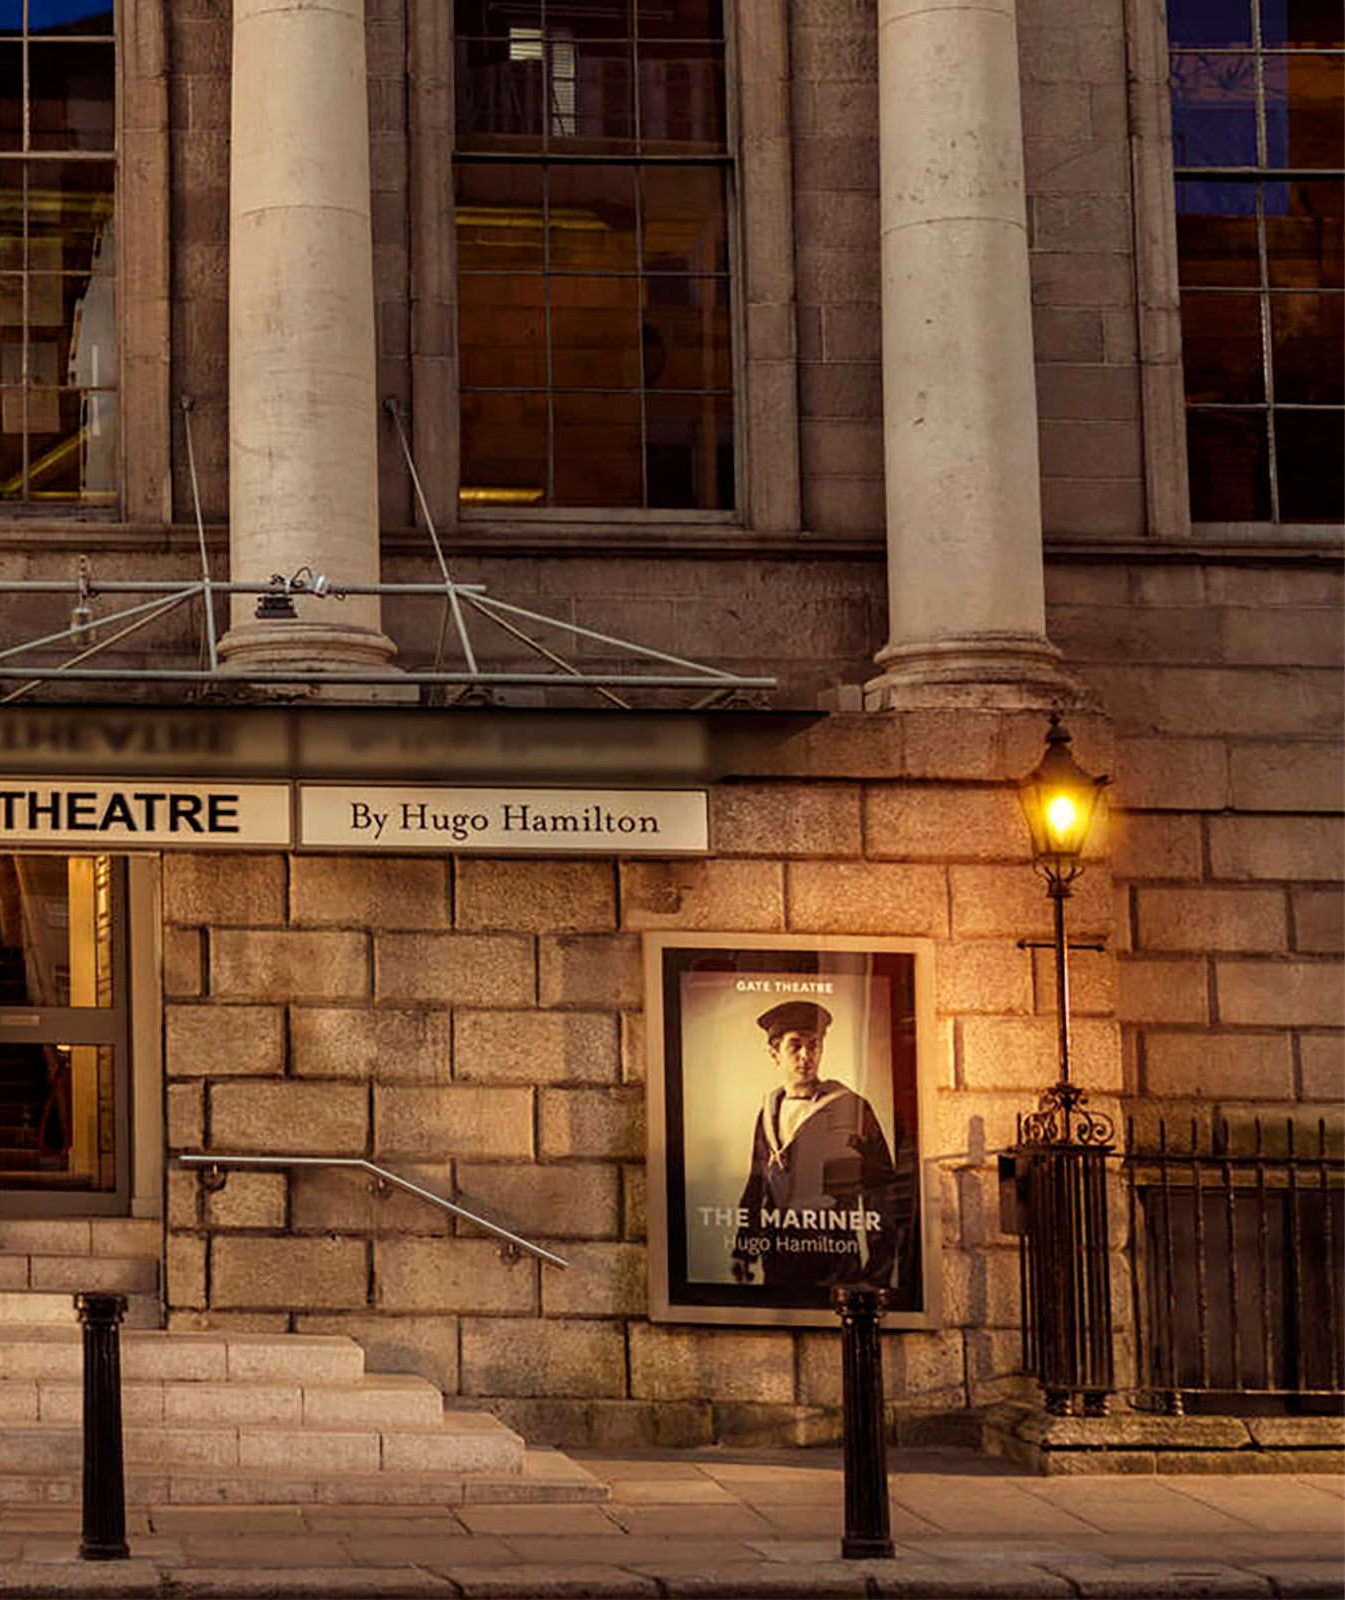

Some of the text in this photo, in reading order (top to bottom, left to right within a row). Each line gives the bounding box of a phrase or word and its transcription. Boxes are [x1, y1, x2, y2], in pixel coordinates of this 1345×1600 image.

[350, 803, 662, 840] By Hugo Hamilton
[736, 980, 834, 993] GATE THEATRE
[698, 1206, 881, 1231] THE MARINER
[723, 1235, 859, 1256] Hugo Hamilton
